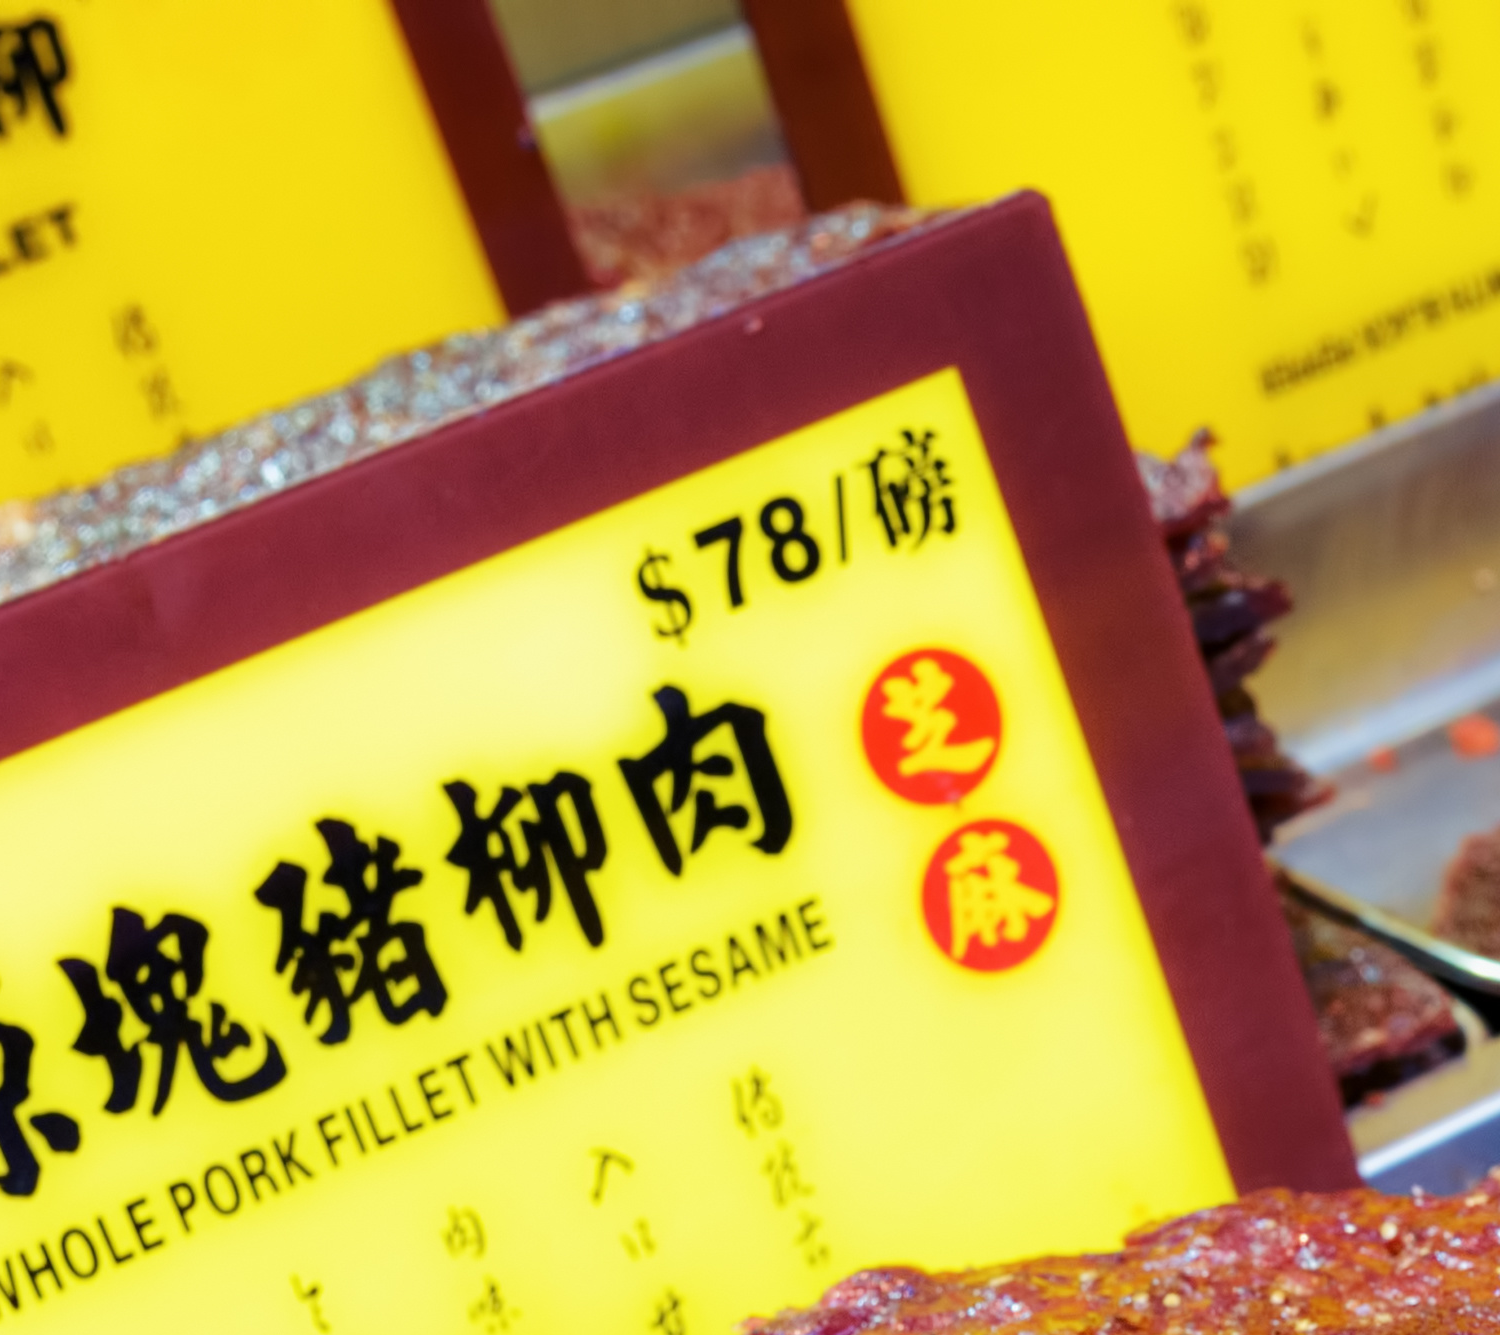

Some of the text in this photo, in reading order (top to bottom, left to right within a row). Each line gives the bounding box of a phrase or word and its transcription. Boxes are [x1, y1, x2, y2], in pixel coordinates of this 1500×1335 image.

[633, 426, 962, 646] $78/磅
[166, 1130, 316, 1238] PORK
[315, 1053, 482, 1168] FILLET
[480, 994, 622, 1093] WITH
[626, 898, 835, 1030] SESAME
